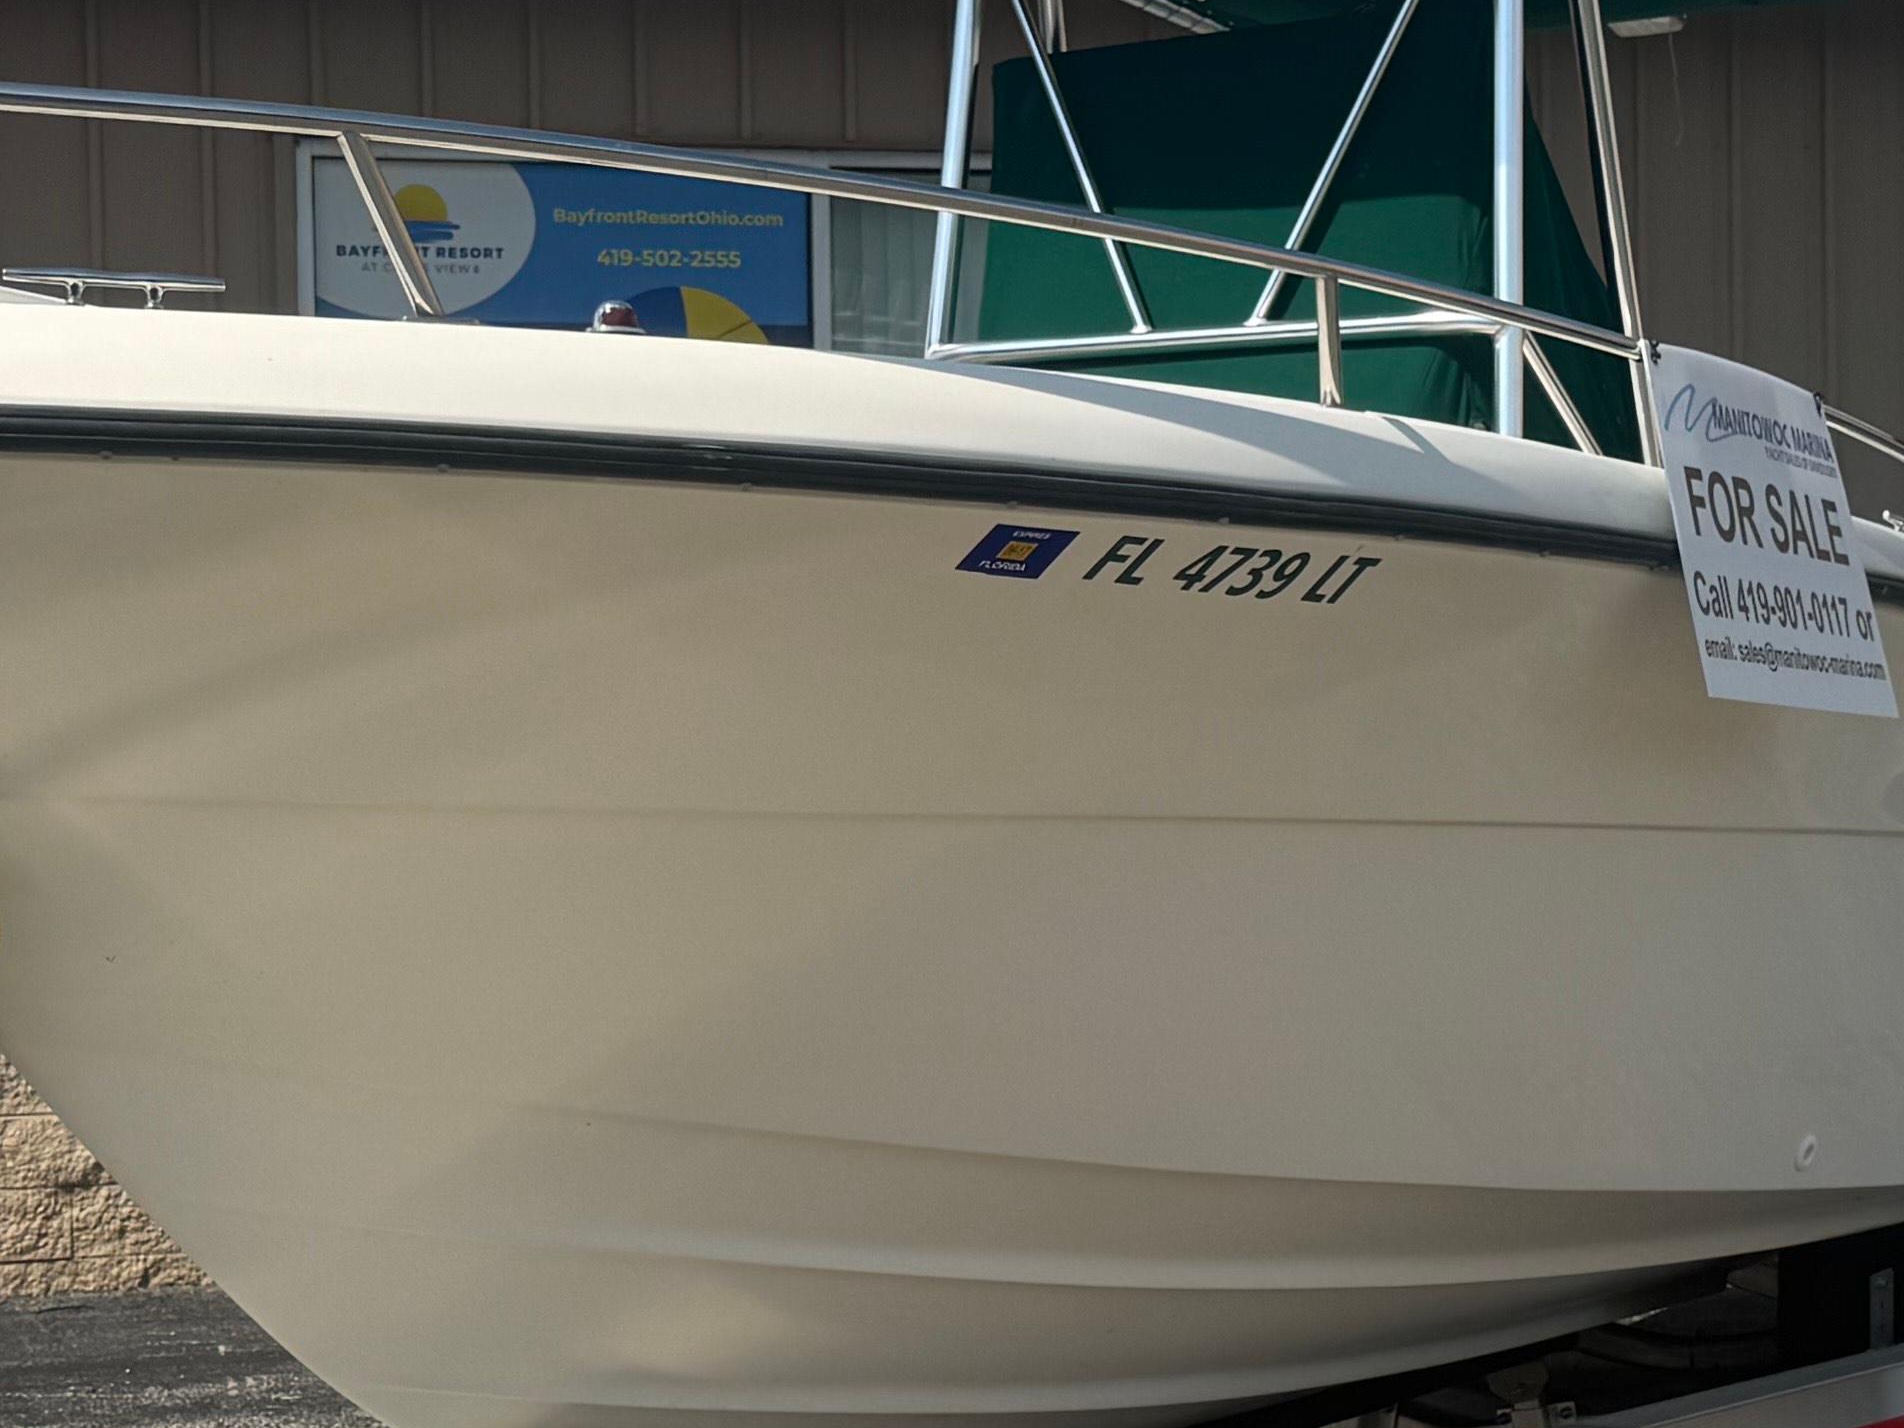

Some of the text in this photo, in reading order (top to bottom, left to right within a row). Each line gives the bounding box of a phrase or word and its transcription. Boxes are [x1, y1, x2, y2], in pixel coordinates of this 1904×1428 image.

[553, 208, 784, 227] BayfrontResortOhio.com
[436, 247, 504, 260] RESORT
[597, 249, 742, 269] 419-502-2555
[1712, 402, 1791, 449] MANITOWOC
[1683, 465, 1850, 566] FOR SALE
[1082, 535, 1382, 604] FL 4739 LT
[1693, 570, 1875, 642] Call 419-901-0117 or
[1705, 636, 1738, 661] email:
